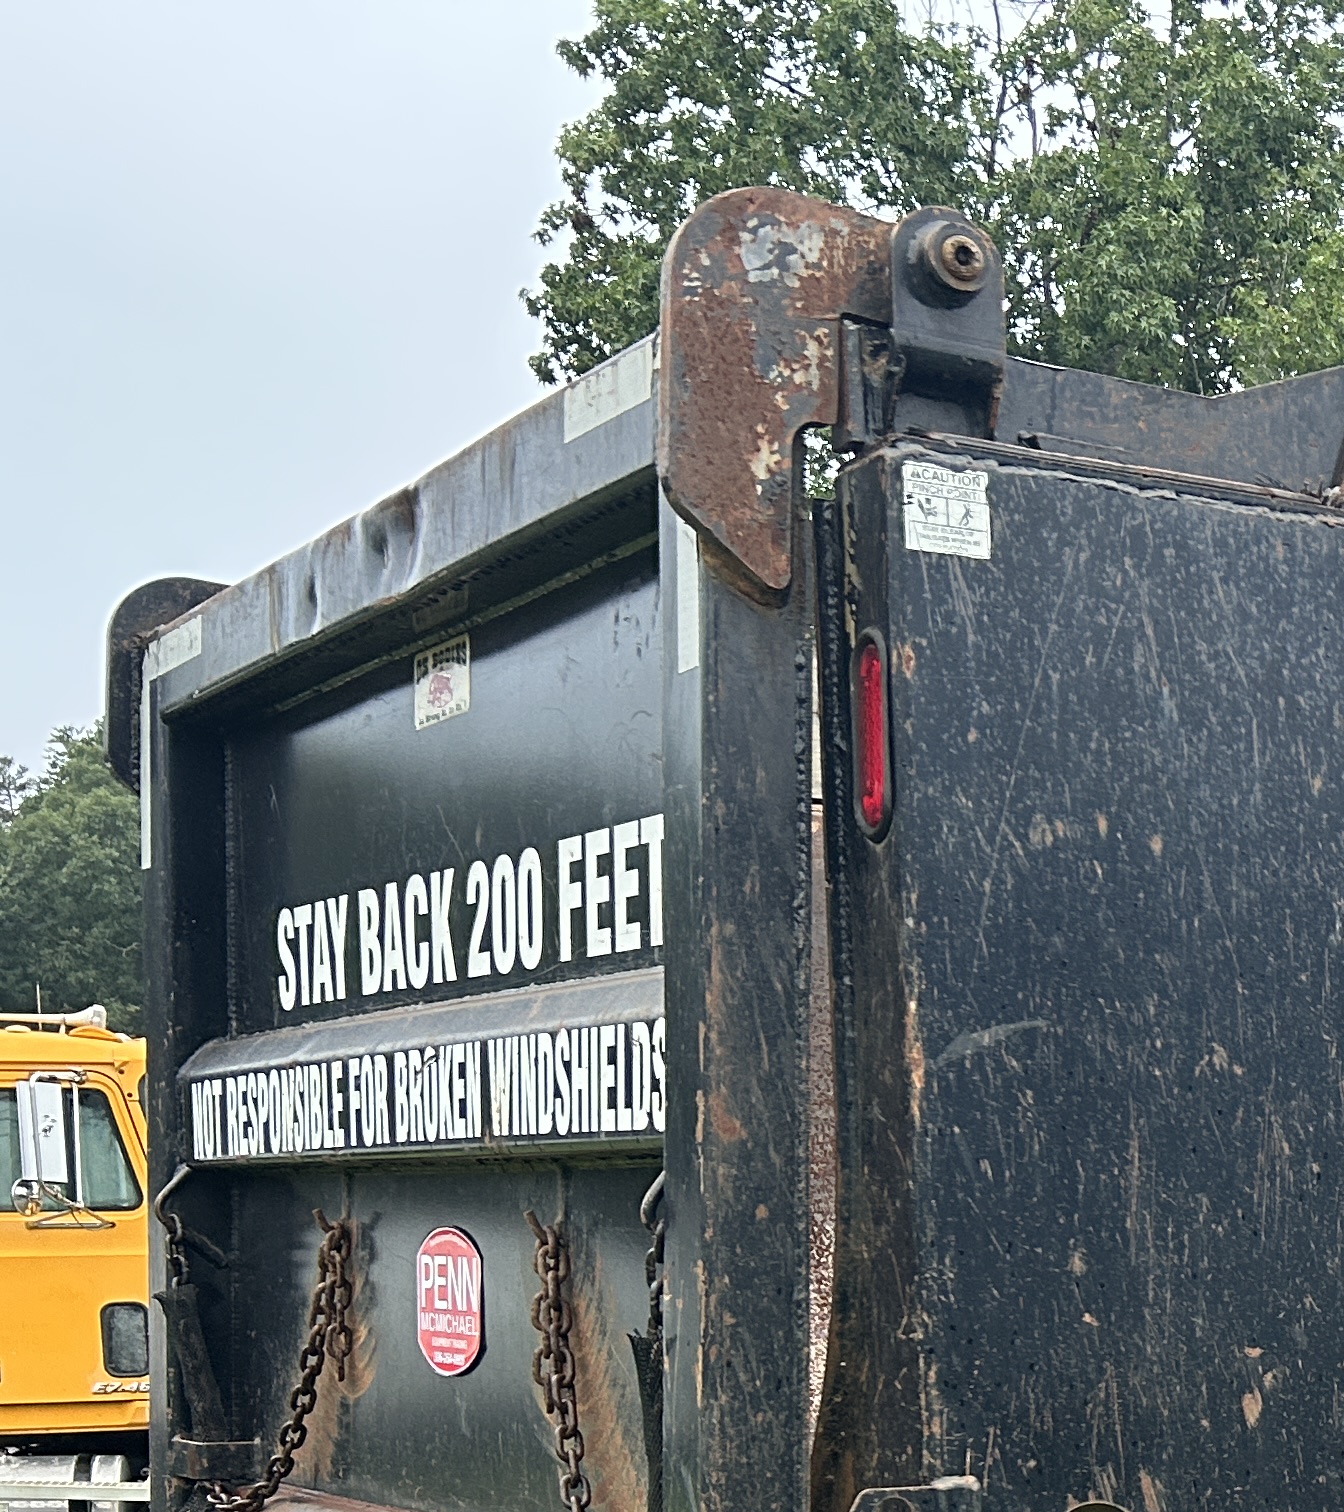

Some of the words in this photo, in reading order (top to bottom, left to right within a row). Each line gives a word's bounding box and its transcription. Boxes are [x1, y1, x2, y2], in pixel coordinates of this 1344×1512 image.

[911, 482, 944, 496] PINCH
[921, 468, 981, 488] CAUTION
[278, 894, 349, 1011] STAY
[358, 867, 457, 996] BACK
[466, 846, 543, 978] 200
[557, 813, 664, 962] FEET
[191, 1078, 223, 1161] NOT
[226, 1061, 345, 1156] RESPONSIBLE
[349, 1053, 390, 1148] FOR
[394, 1040, 482, 1144] BROKEN
[487, 1016, 666, 1137] WINDSHIELDS
[420, 1254, 478, 1313] PENN
[420, 1311, 479, 1336] MCMICHAEL
